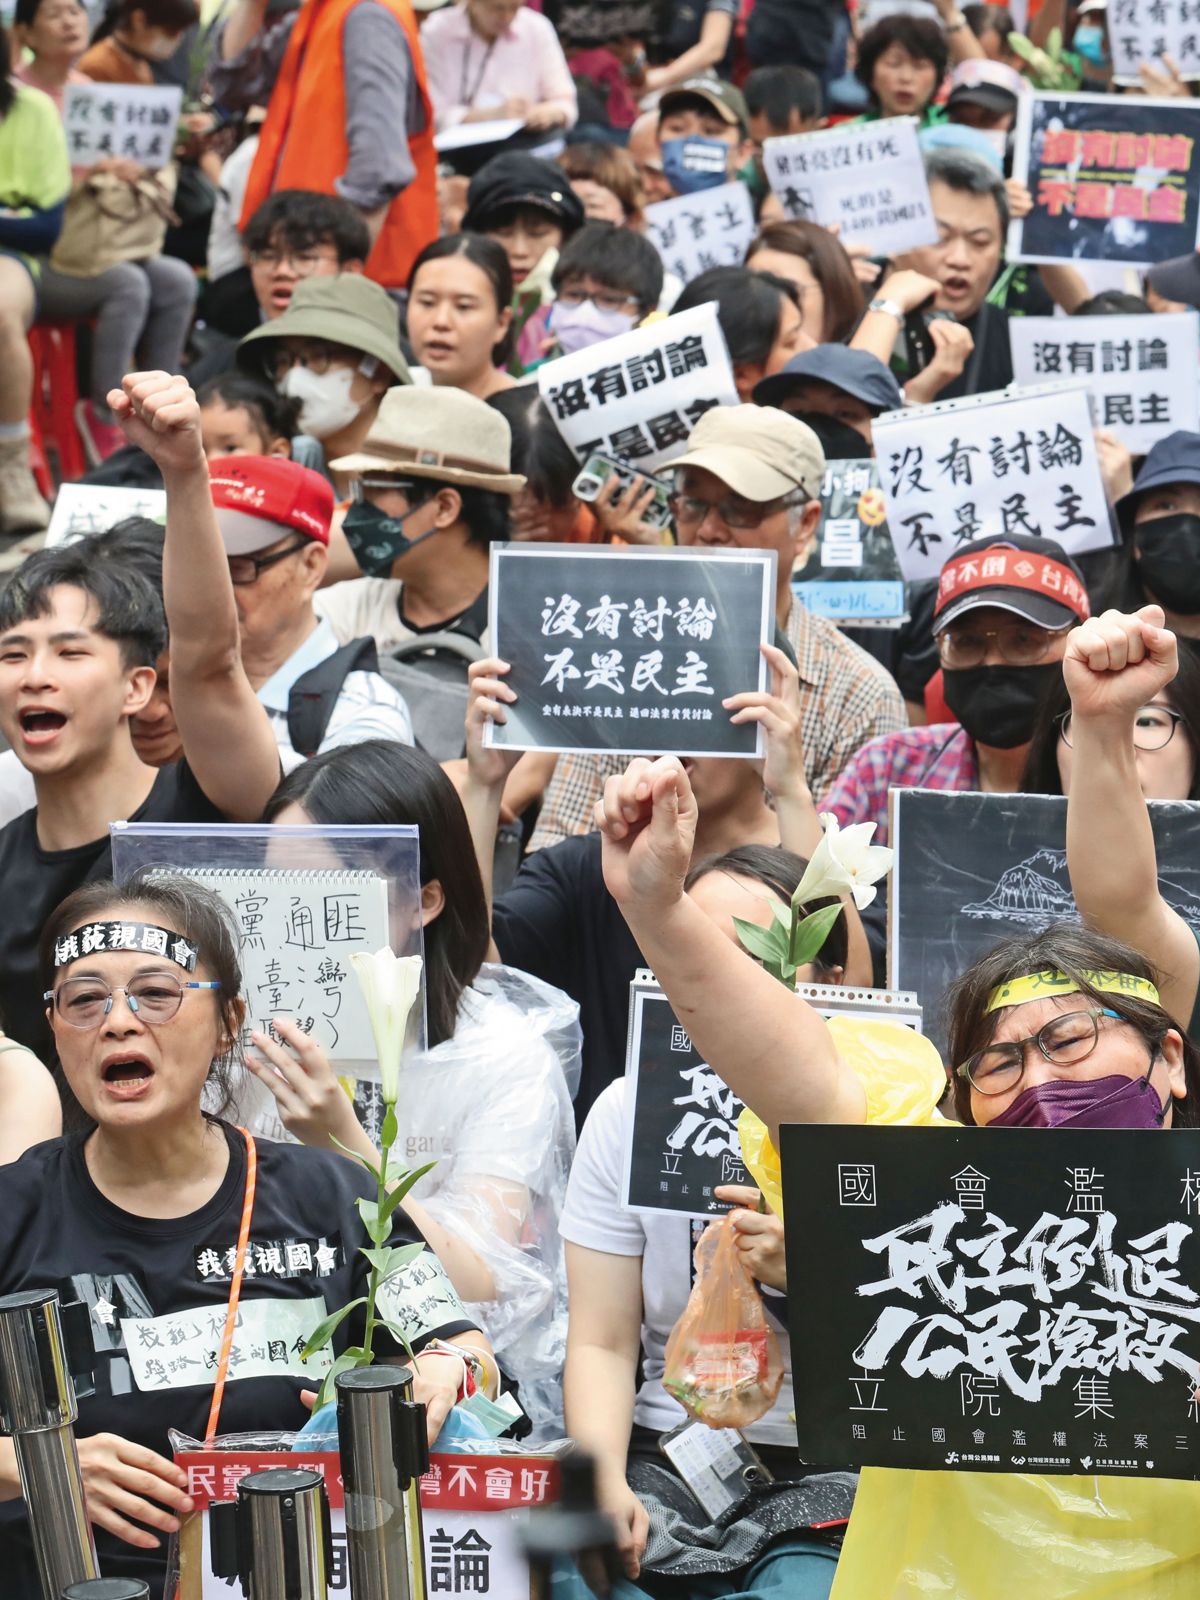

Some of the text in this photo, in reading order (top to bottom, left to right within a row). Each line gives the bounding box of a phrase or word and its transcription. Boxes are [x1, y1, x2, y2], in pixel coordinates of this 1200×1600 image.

[549, 335, 708, 420] 沒有討論
[1033, 338, 1169, 374] 沒有討論
[889, 423, 1084, 498] 沒有討論
[901, 484, 1096, 556] 不是民主
[540, 593, 718, 641] 沒有討論
[540, 647, 716, 696] 不是民主
[57, 923, 198, 970] 我藐視國會
[672, 1063, 747, 1120] 民
[187, 1463, 326, 1498] 民黨
